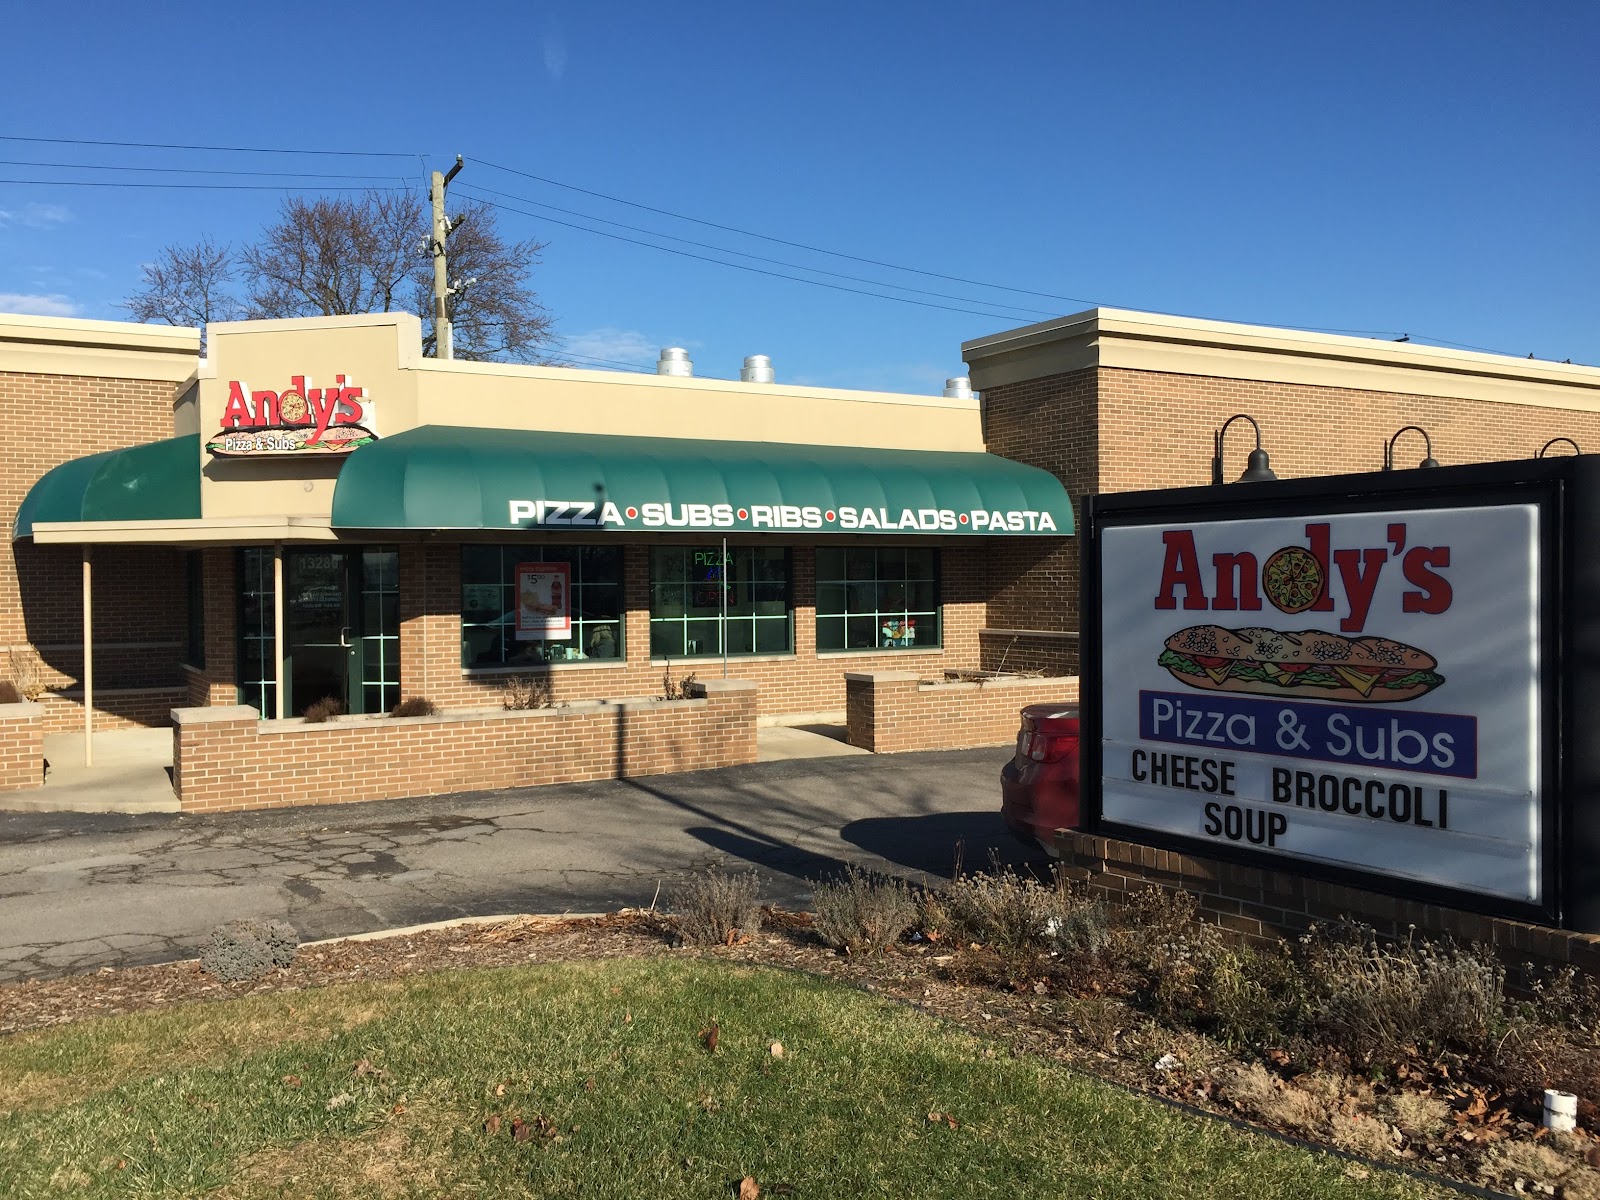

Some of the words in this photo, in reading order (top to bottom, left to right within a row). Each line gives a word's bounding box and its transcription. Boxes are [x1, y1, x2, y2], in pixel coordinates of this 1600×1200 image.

[220, 374, 364, 445] Andy's
[225, 437, 253, 451] Pizza
[255, 437, 264, 450] &
[267, 436, 296, 451] Subs
[508, 500, 625, 526] PIZZA
[641, 502, 735, 528] SUBS
[751, 504, 823, 529] RIBS
[838, 506, 958, 531] SALADS
[970, 510, 1058, 532] PASTA
[694, 552, 734, 566] PIZZA
[1154, 522, 1454, 633] Andy's
[1152, 698, 1256, 746] Pizza
[1275, 708, 1311, 752] &
[1326, 713, 1456, 769] Subs
[1131, 749, 1236, 796] CHEESE
[1272, 767, 1448, 829] BROCCOLI
[1204, 802, 1288, 847] SOUP
